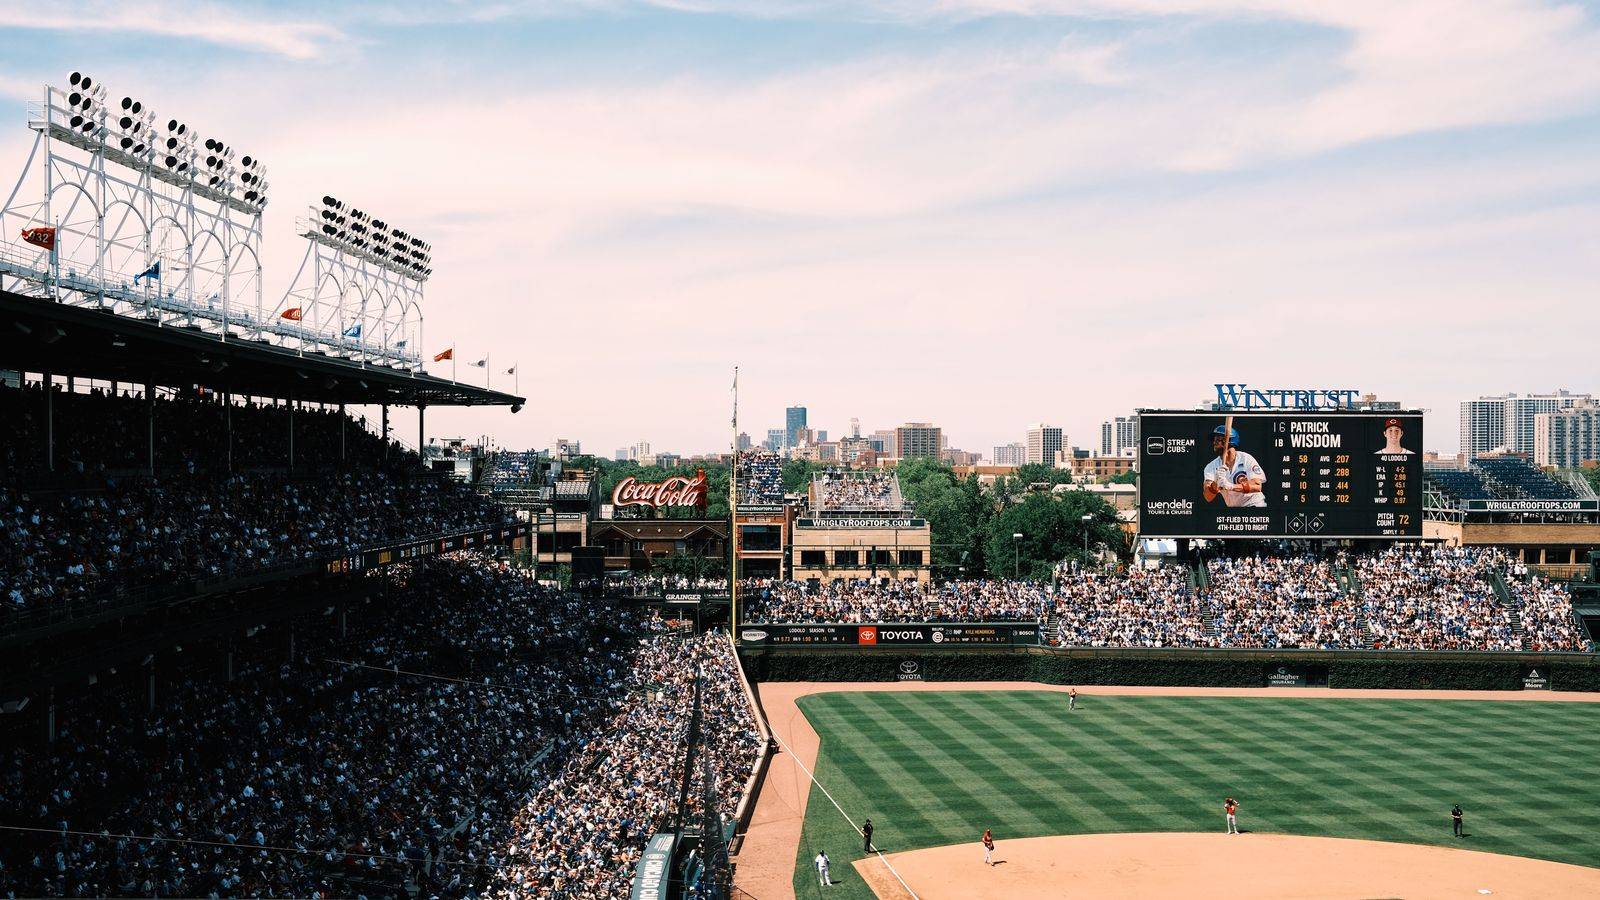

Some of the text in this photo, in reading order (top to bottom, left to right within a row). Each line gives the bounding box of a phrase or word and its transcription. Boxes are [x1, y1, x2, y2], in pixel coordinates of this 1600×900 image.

[1214, 384, 1359, 410] WINTRUST
[1273, 421, 1286, 433] 16
[1290, 421, 1329, 433] PATRICK
[1290, 434, 1341, 448] WISDOM
[1298, 455, 1308, 463] 58
[1334, 455, 1350, 463] .207
[1300, 468, 1306, 476] 2
[1299, 481, 1307, 490] 10
[1335, 481, 1349, 490] .414
[613, 476, 702, 507] Coca-Cola
[1300, 494, 1306, 503] 5
[1334, 494, 1350, 503] .702
[1147, 498, 1193, 509] wendella
[1486, 501, 1581, 510] WRIGLEYROOFTOPS.COM
[812, 519, 911, 527] WRIGLEYROOFTOPS.COM
[1376, 519, 1395, 527] COUNT
[1398, 514, 1410, 525] 72
[880, 631, 924, 640] TOYOTA
[1267, 673, 1300, 681] Gallagher
[641, 860, 663, 888] CHICAGO
